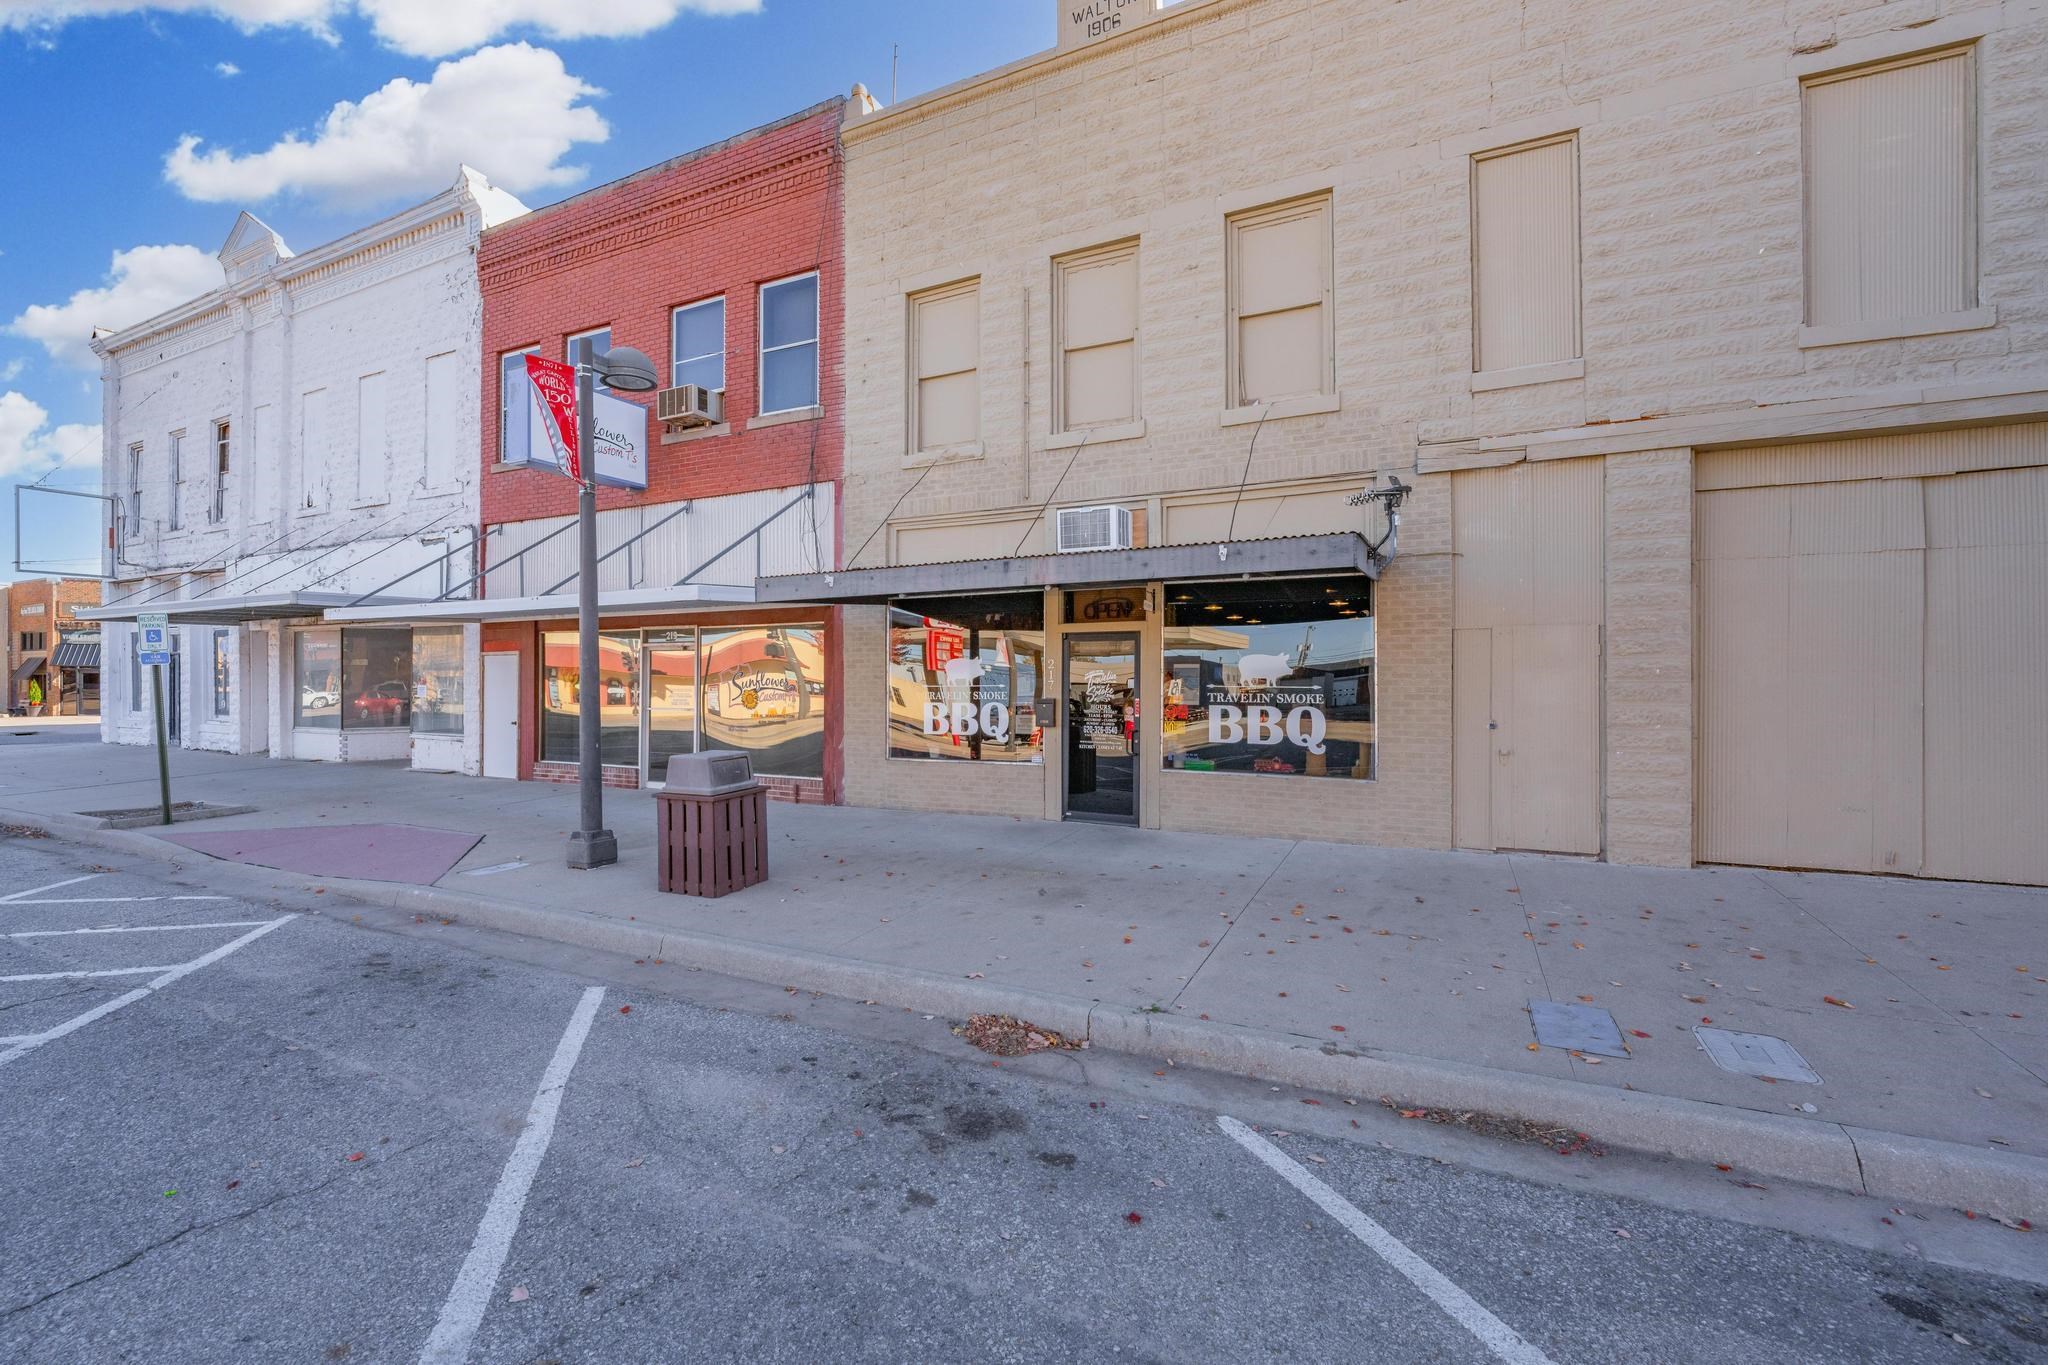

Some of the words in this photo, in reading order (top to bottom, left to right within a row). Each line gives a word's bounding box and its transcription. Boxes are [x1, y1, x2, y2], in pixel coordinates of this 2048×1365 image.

[1072, 0, 1136, 24] WALTO
[1087, 12, 1120, 37] 1906
[543, 360, 558, 371] 1871
[539, 374, 566, 391] WORLD
[543, 388, 571, 405] 150
[593, 417, 634, 450] lower
[1084, 601, 1131, 620] OPEN
[666, 631, 678, 640] 219
[1047, 659, 1055, 690] 217
[731, 670, 796, 702] Sunflower
[973, 691, 1008, 701] SMOKE
[1207, 692, 1274, 704] TRAVELIN'
[1276, 693, 1325, 705] SMOKE
[923, 701, 1009, 743] BBQ
[1208, 704, 1327, 755] BBQ
